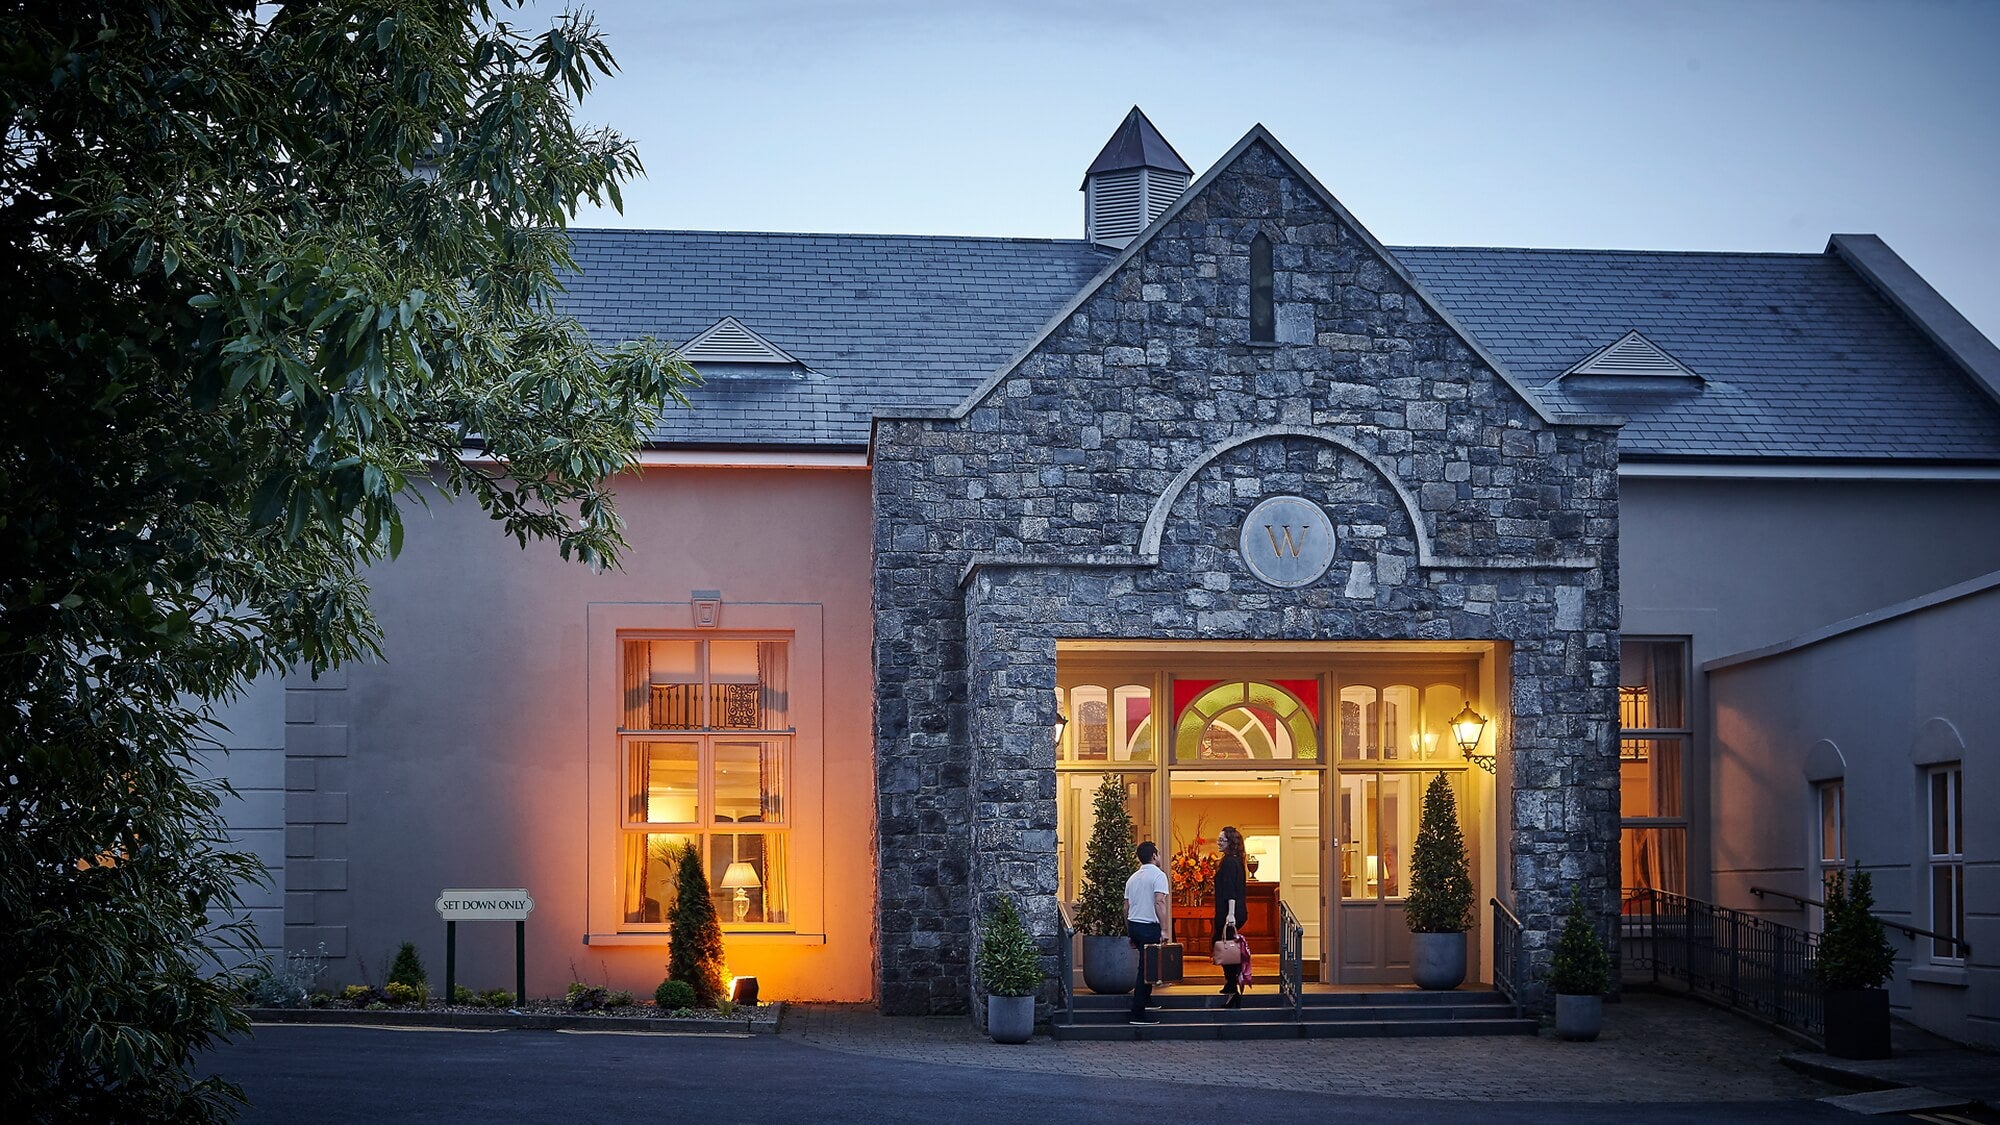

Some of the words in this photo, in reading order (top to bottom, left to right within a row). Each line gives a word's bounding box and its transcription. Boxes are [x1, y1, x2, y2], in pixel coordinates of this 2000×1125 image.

[1264, 525, 1310, 558] W
[443, 900, 460, 910] SET
[462, 900, 496, 910] DOWN
[498, 900, 526, 910] ONLY
